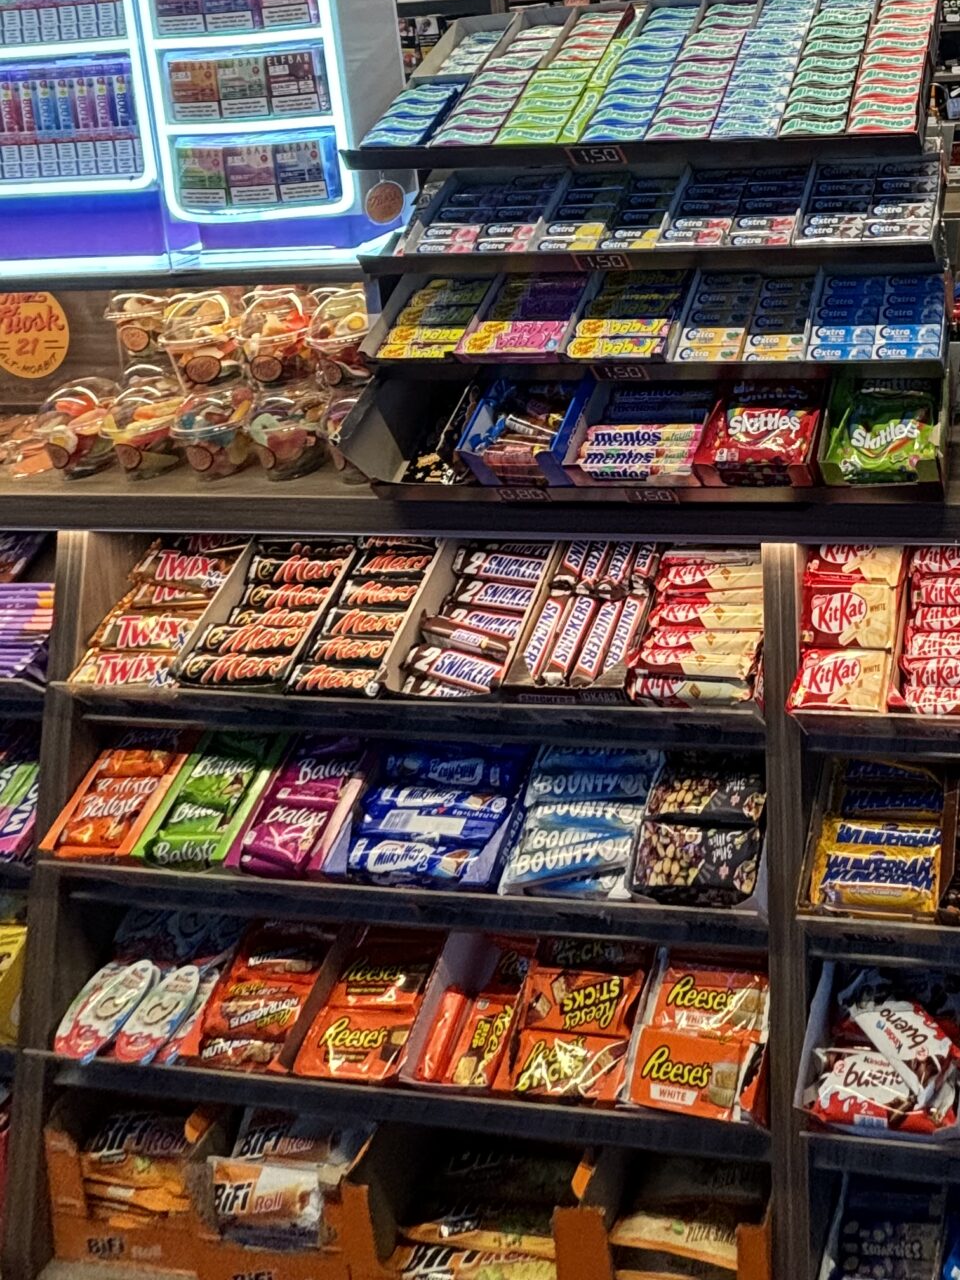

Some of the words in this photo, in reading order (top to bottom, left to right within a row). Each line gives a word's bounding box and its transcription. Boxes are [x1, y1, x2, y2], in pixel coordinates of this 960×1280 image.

[855, 85, 920, 98] Airwaves
[786, 102, 849, 118] Airwaves
[648, 123, 711, 138] Airwaves
[781, 119, 844, 134] Airwaves
[850, 117, 913, 130] Airwaves
[582, 149, 619, 162] 1,50
[588, 255, 625, 269] 1,50
[16, 338, 39, 357] 21
[728, 410, 801, 436] Skittles
[594, 429, 662, 443] mentos
[851, 421, 919, 449] Skittles
[157, 549, 218, 581] Twix
[273, 554, 344, 582] Mars
[814, 596, 865, 631] KitKat
[869, 602, 887, 613] WHITE
[333, 611, 408, 635] Mars
[552, 596, 593, 664] SNICKERS
[580, 601, 622, 670] SNICKERS
[96, 653, 162, 687] Twix
[201, 652, 292, 683] Mars
[538, 773, 617, 794] BOUNTY
[321, 1017, 387, 1050] Reese's
[642, 1045, 712, 1088] Reese's
[842, 1065, 904, 1088] bueno
[658, 1086, 689, 1103] WHITE
[214, 1182, 251, 1213] BiFi
[254, 1192, 282, 1213] Roll
